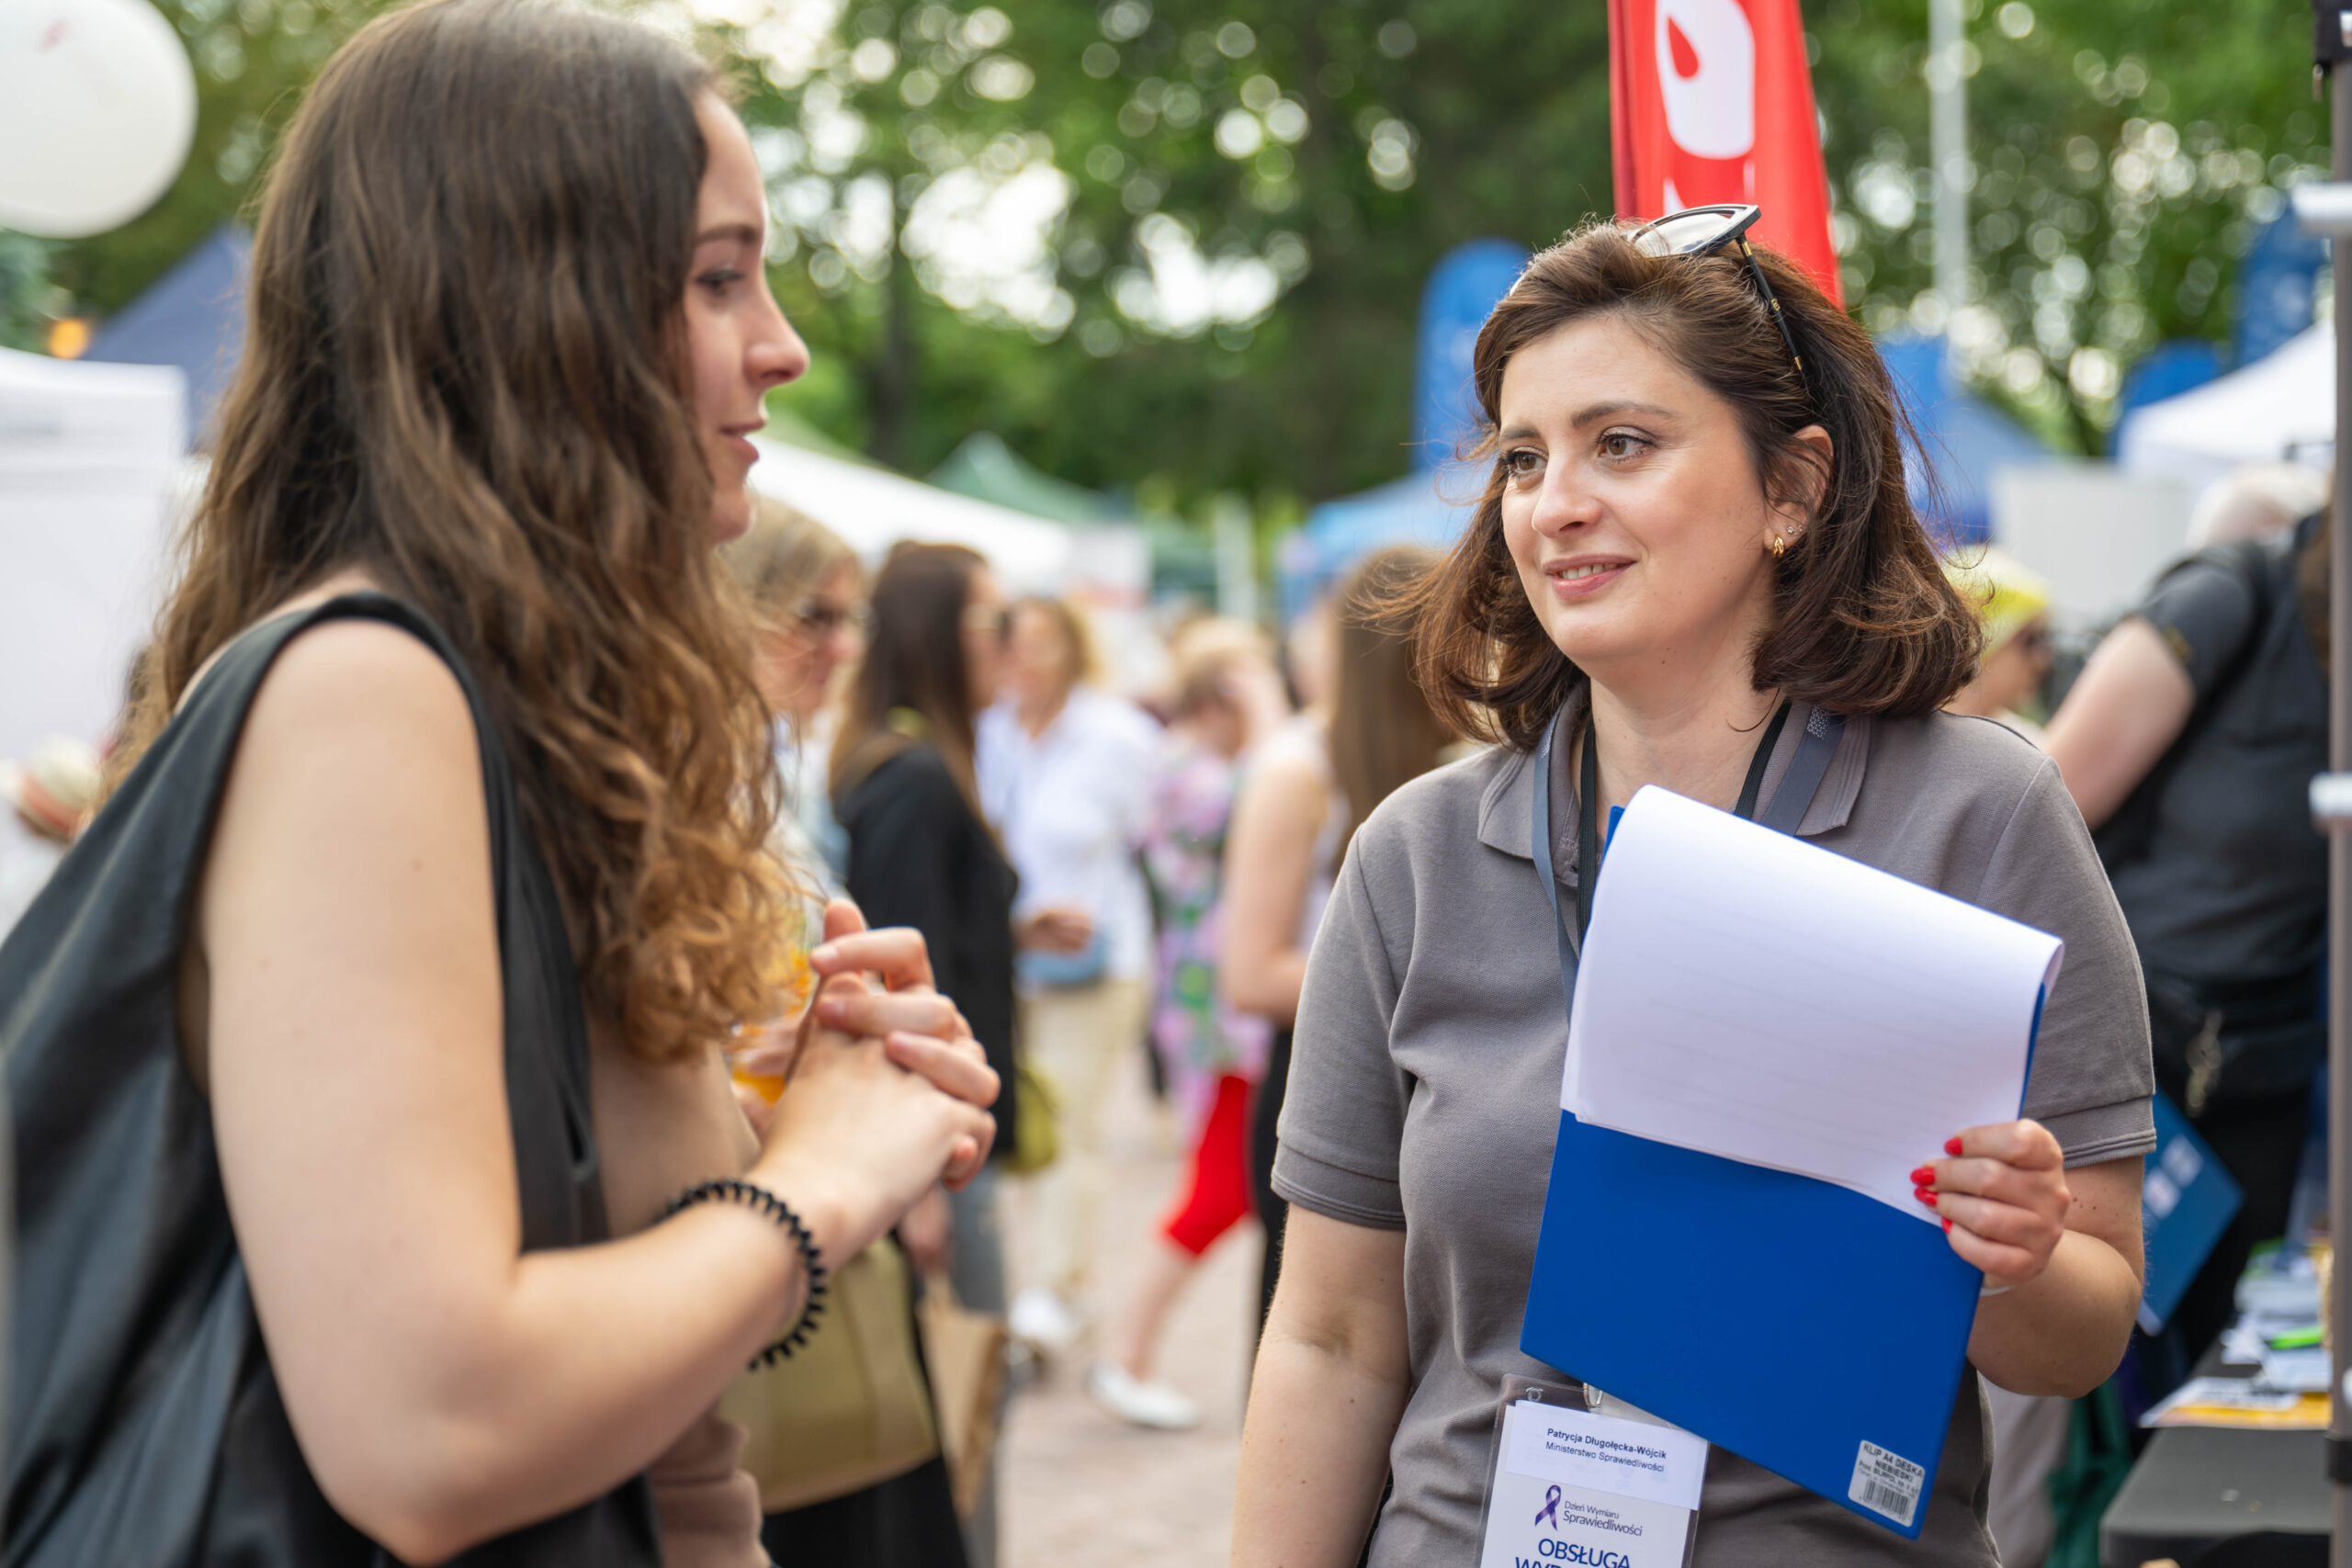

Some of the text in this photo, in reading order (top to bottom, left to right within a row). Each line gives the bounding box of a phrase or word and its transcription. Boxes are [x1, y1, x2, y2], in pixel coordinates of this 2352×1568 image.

[1545, 1441, 1665, 1472] Ministerstwo Sprawiedliwości
[1547, 1428, 1667, 1460] Patrycja Długołęcka-Wójcik
[1863, 1442, 1882, 1456] KLIP
[1883, 1452, 1894, 1463] A4
[1563, 1510, 1643, 1537] Sprawiedliwości
[1564, 1500, 1620, 1520] Dzień Wymiaru
[1538, 1538, 1631, 1568] OBSŁUGA
